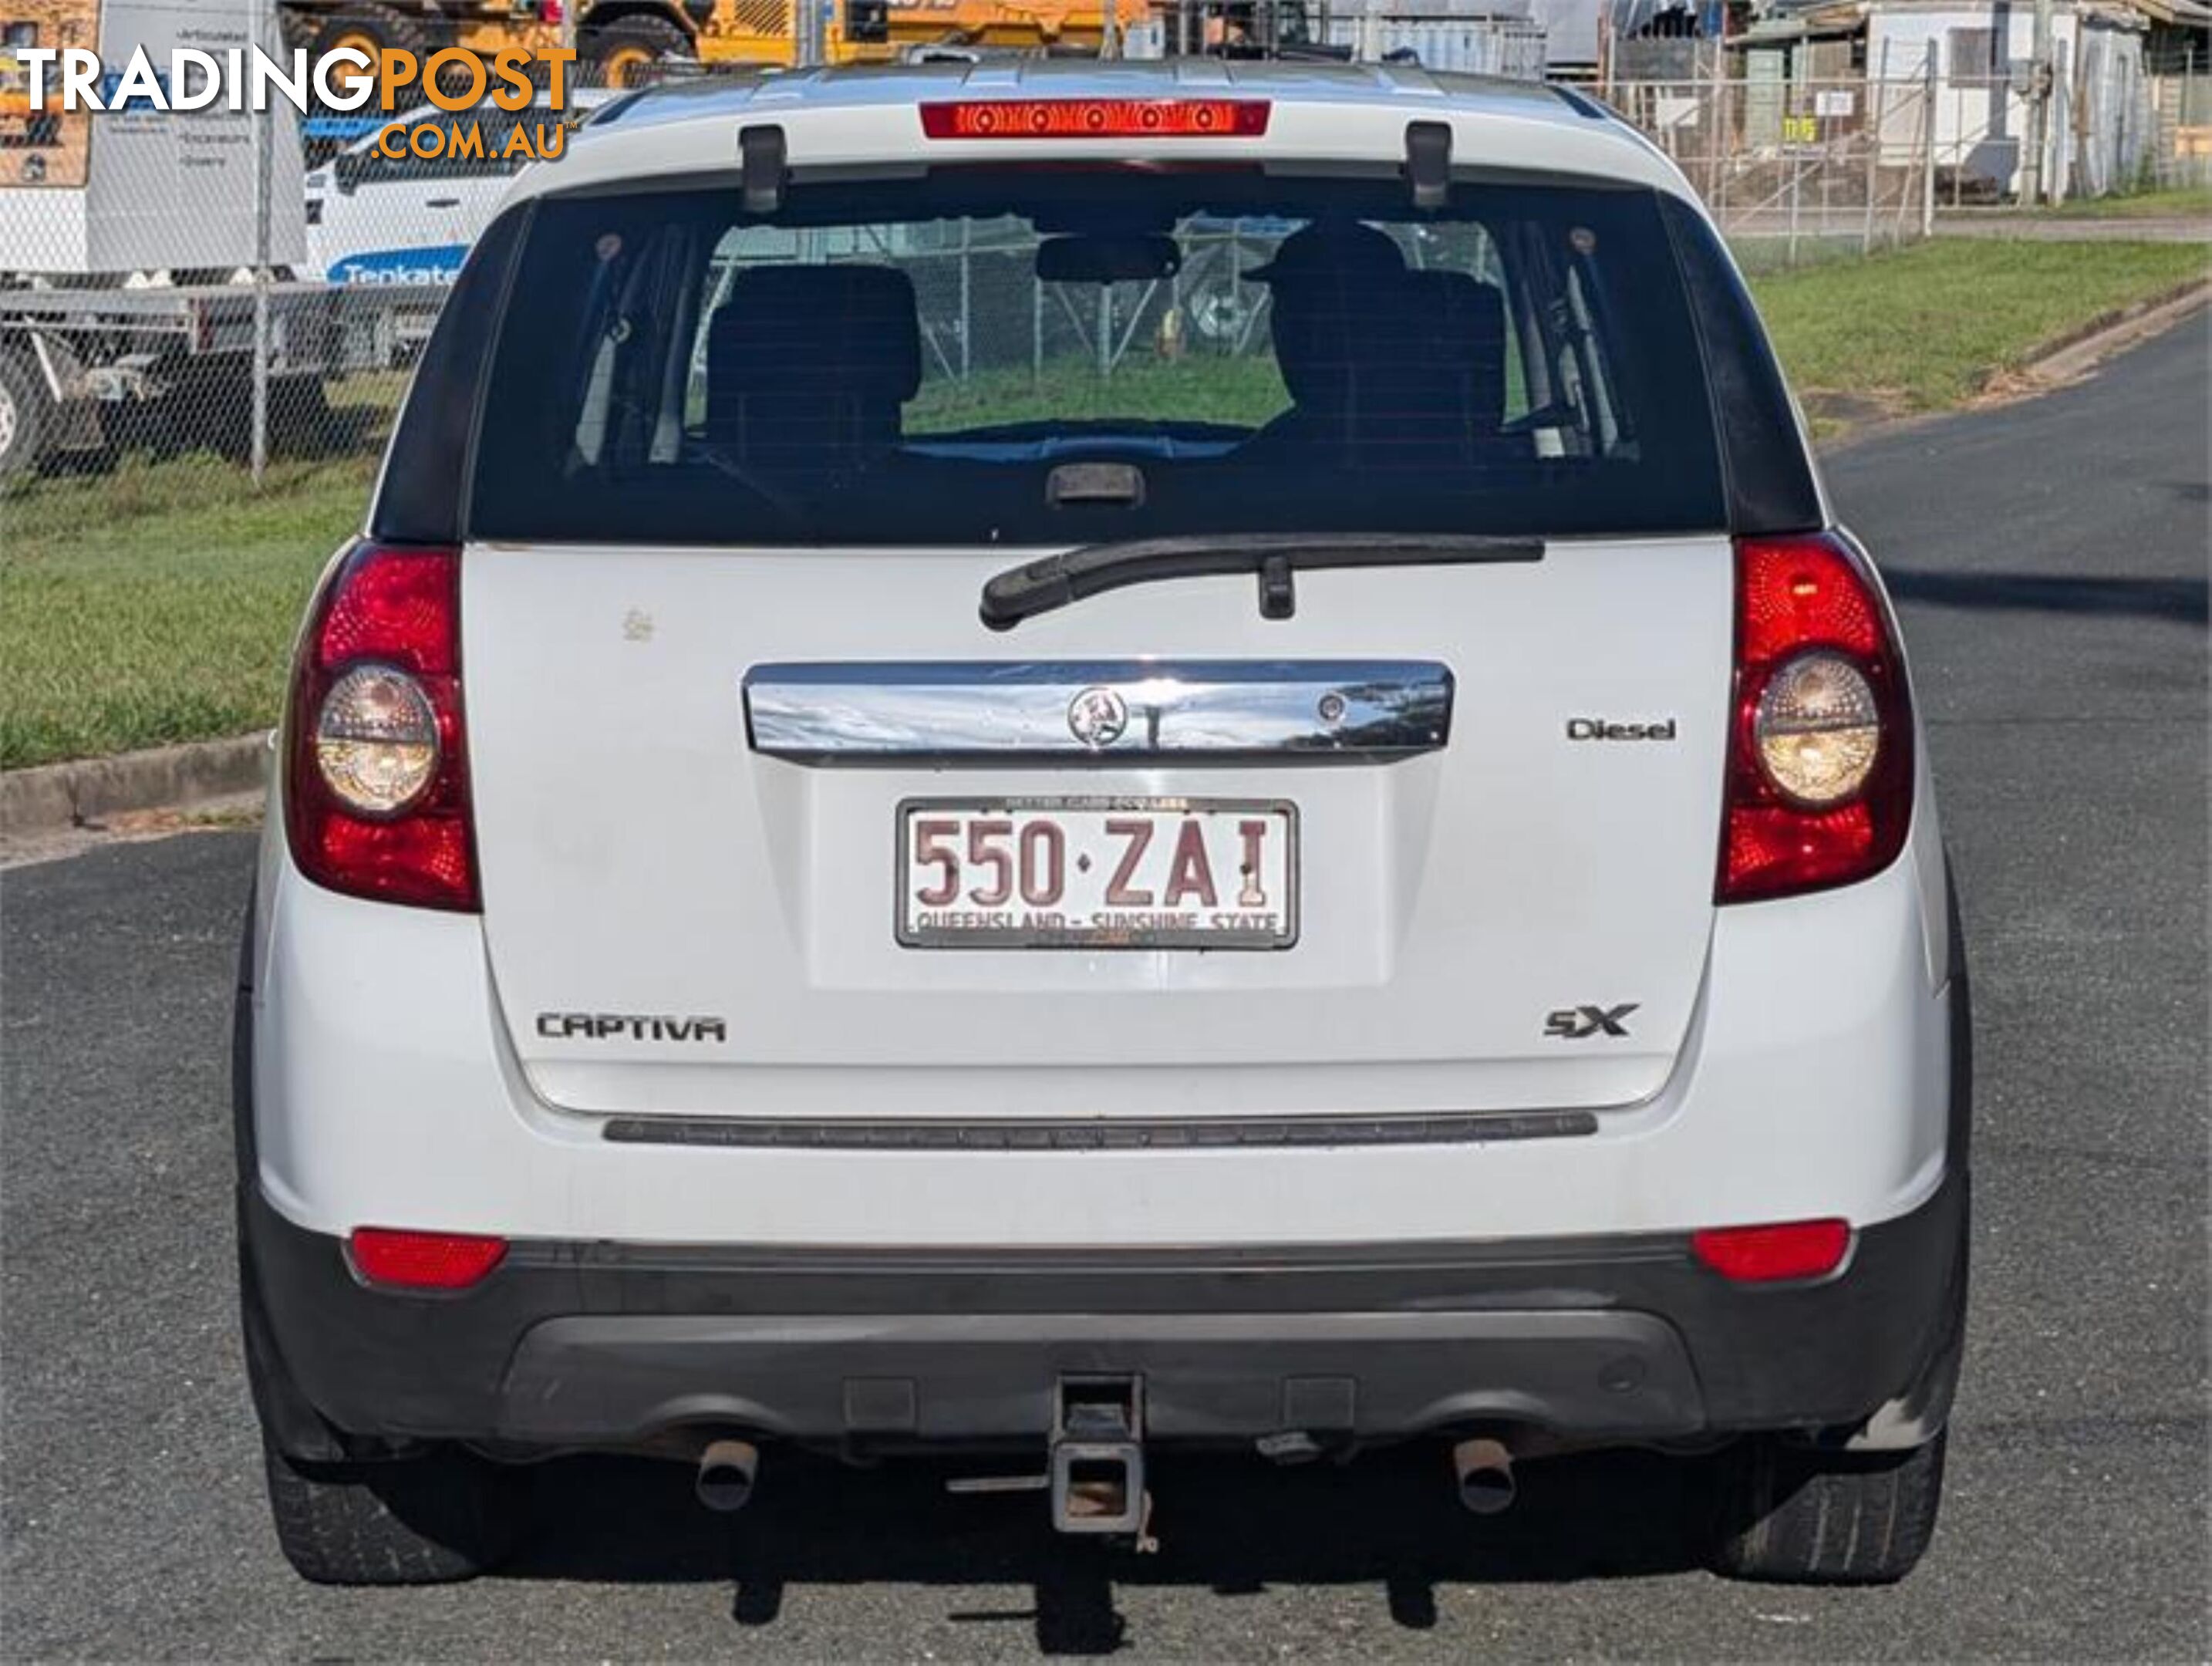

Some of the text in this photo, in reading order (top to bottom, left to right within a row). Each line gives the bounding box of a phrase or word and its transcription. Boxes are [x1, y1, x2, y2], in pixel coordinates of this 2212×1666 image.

[1567, 719, 1676, 740] Diesel
[917, 912, 1066, 929] QUEENSLAND
[1091, 912, 1199, 929] SUNSHINE
[1210, 913, 1279, 929] STATE
[537, 1013, 726, 1042] CAPTIVA
